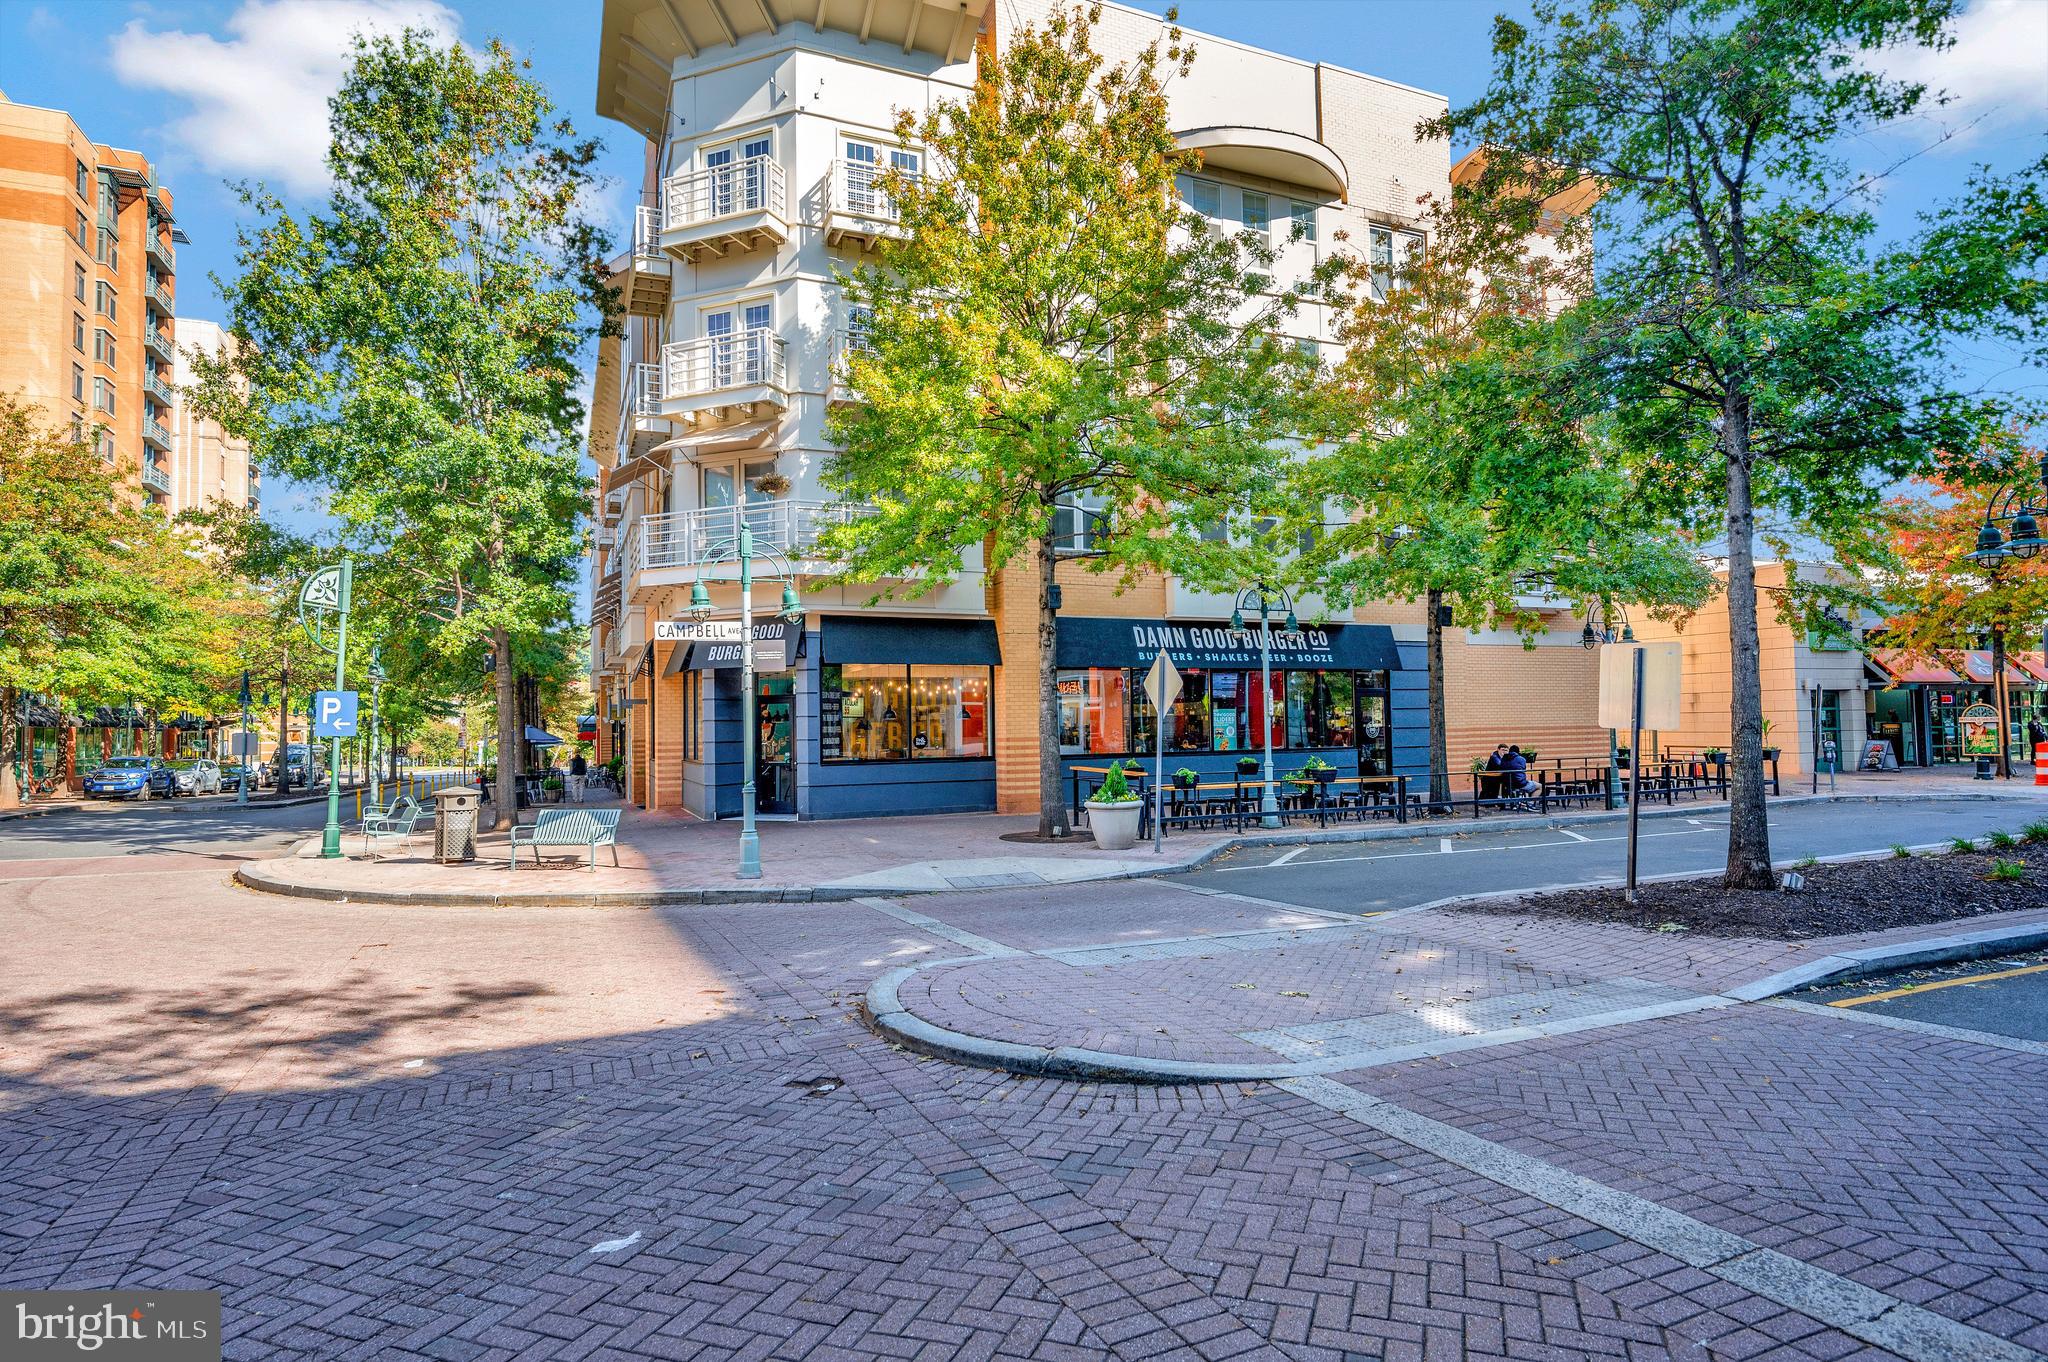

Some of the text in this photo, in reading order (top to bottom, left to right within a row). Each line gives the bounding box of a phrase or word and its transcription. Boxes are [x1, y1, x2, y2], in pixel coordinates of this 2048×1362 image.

[657, 624, 726, 638] CAMPBELL
[751, 623, 785, 640] GOOD
[1132, 625, 1330, 650] DAMN GOOD BURGER CO
[1138, 651, 1194, 661] BUERS
[1204, 653, 1250, 662] SHAKES
[1297, 654, 1335, 663] BOOZE
[322, 697, 342, 724] P
